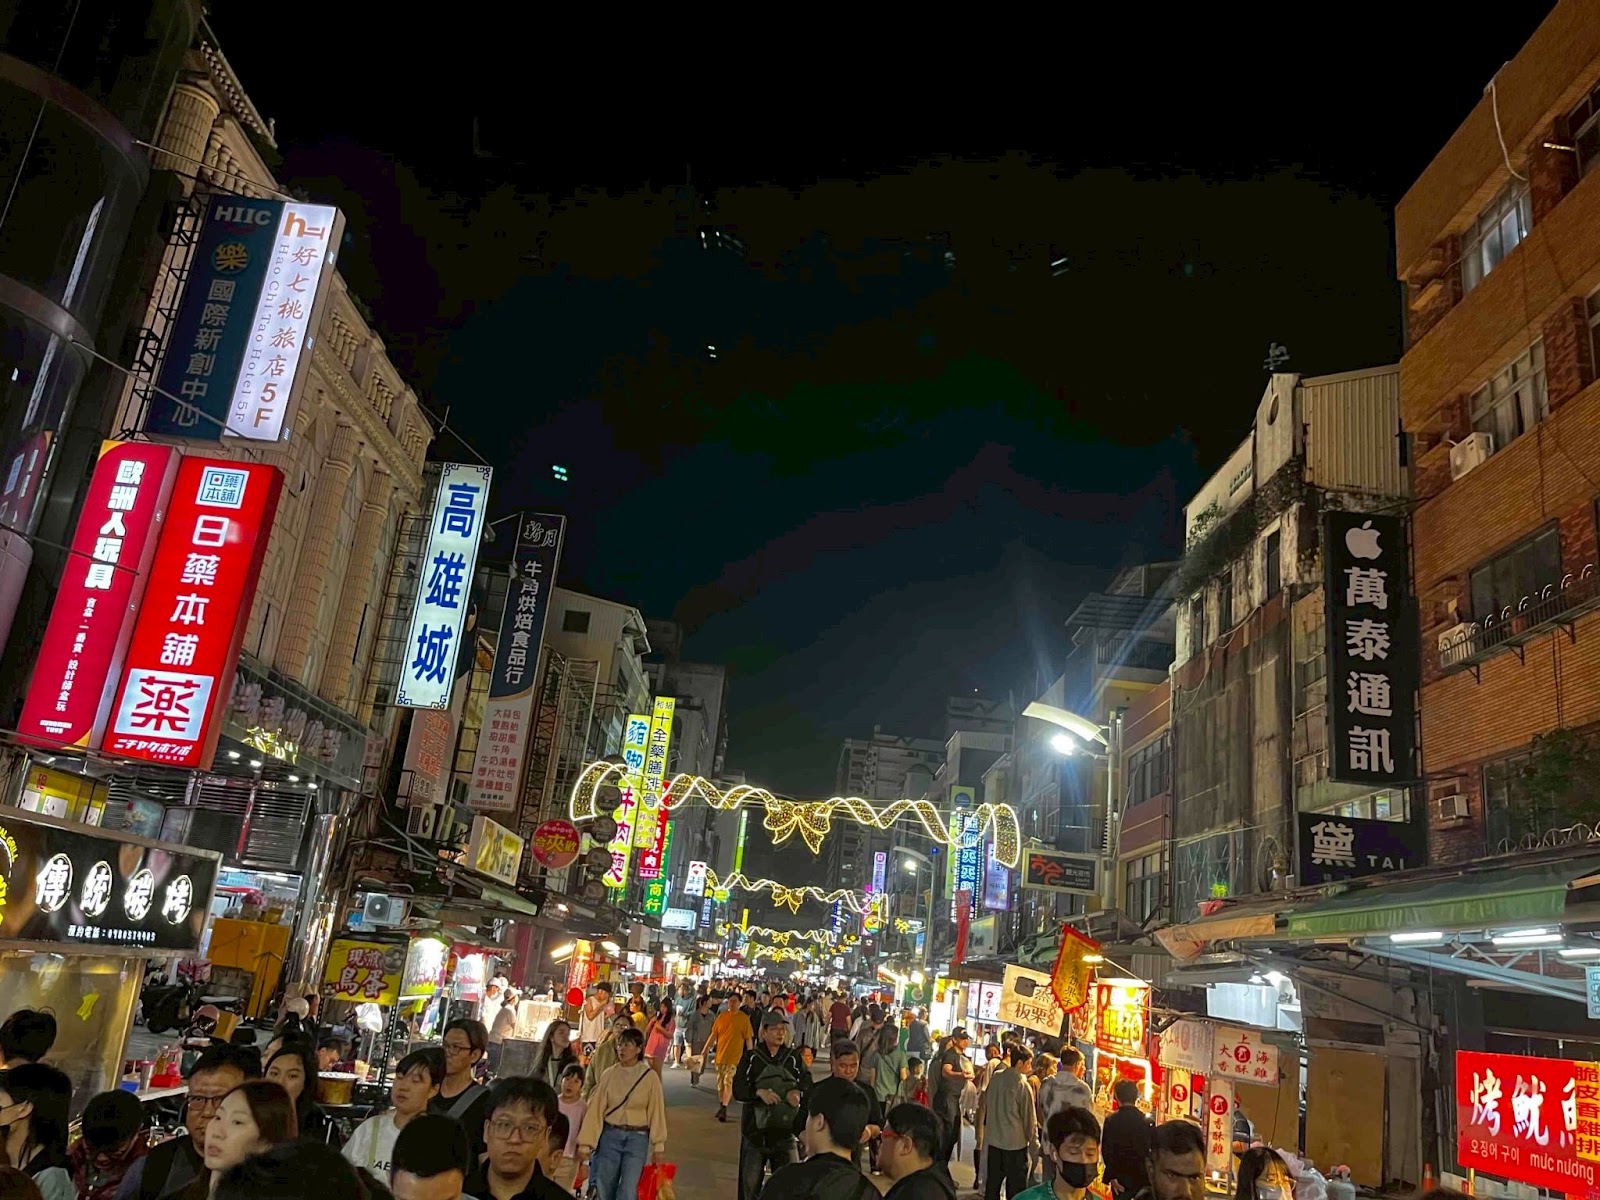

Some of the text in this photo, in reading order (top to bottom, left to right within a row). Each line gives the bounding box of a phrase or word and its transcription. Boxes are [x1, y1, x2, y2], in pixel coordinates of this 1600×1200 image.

[214, 205, 272, 226] HIIC
[215, 242, 247, 272] 樂
[274, 244, 289, 275] Hao
[255, 313, 272, 343] Tao
[172, 279, 236, 427] 國際新創中心
[241, 348, 262, 394] Hotel
[83, 459, 146, 590] 歐洲人玩具
[160, 515, 230, 667] 日藥本舖
[411, 482, 480, 684] 高雄城
[505, 560, 542, 684] 牛角烘焙食品行
[1343, 566, 1394, 774] 萬泰通訊
[644, 712, 670, 809] 十全藥膳排骨
[1310, 821, 1356, 868] 黛
[338, 966, 388, 998] 鳥蛋
[1015, 1002, 1047, 1025] 板栗
[1576, 1066, 1600, 1156] 脆皮香雞排
[1470, 1139, 1520, 1165] 오징어 구이
